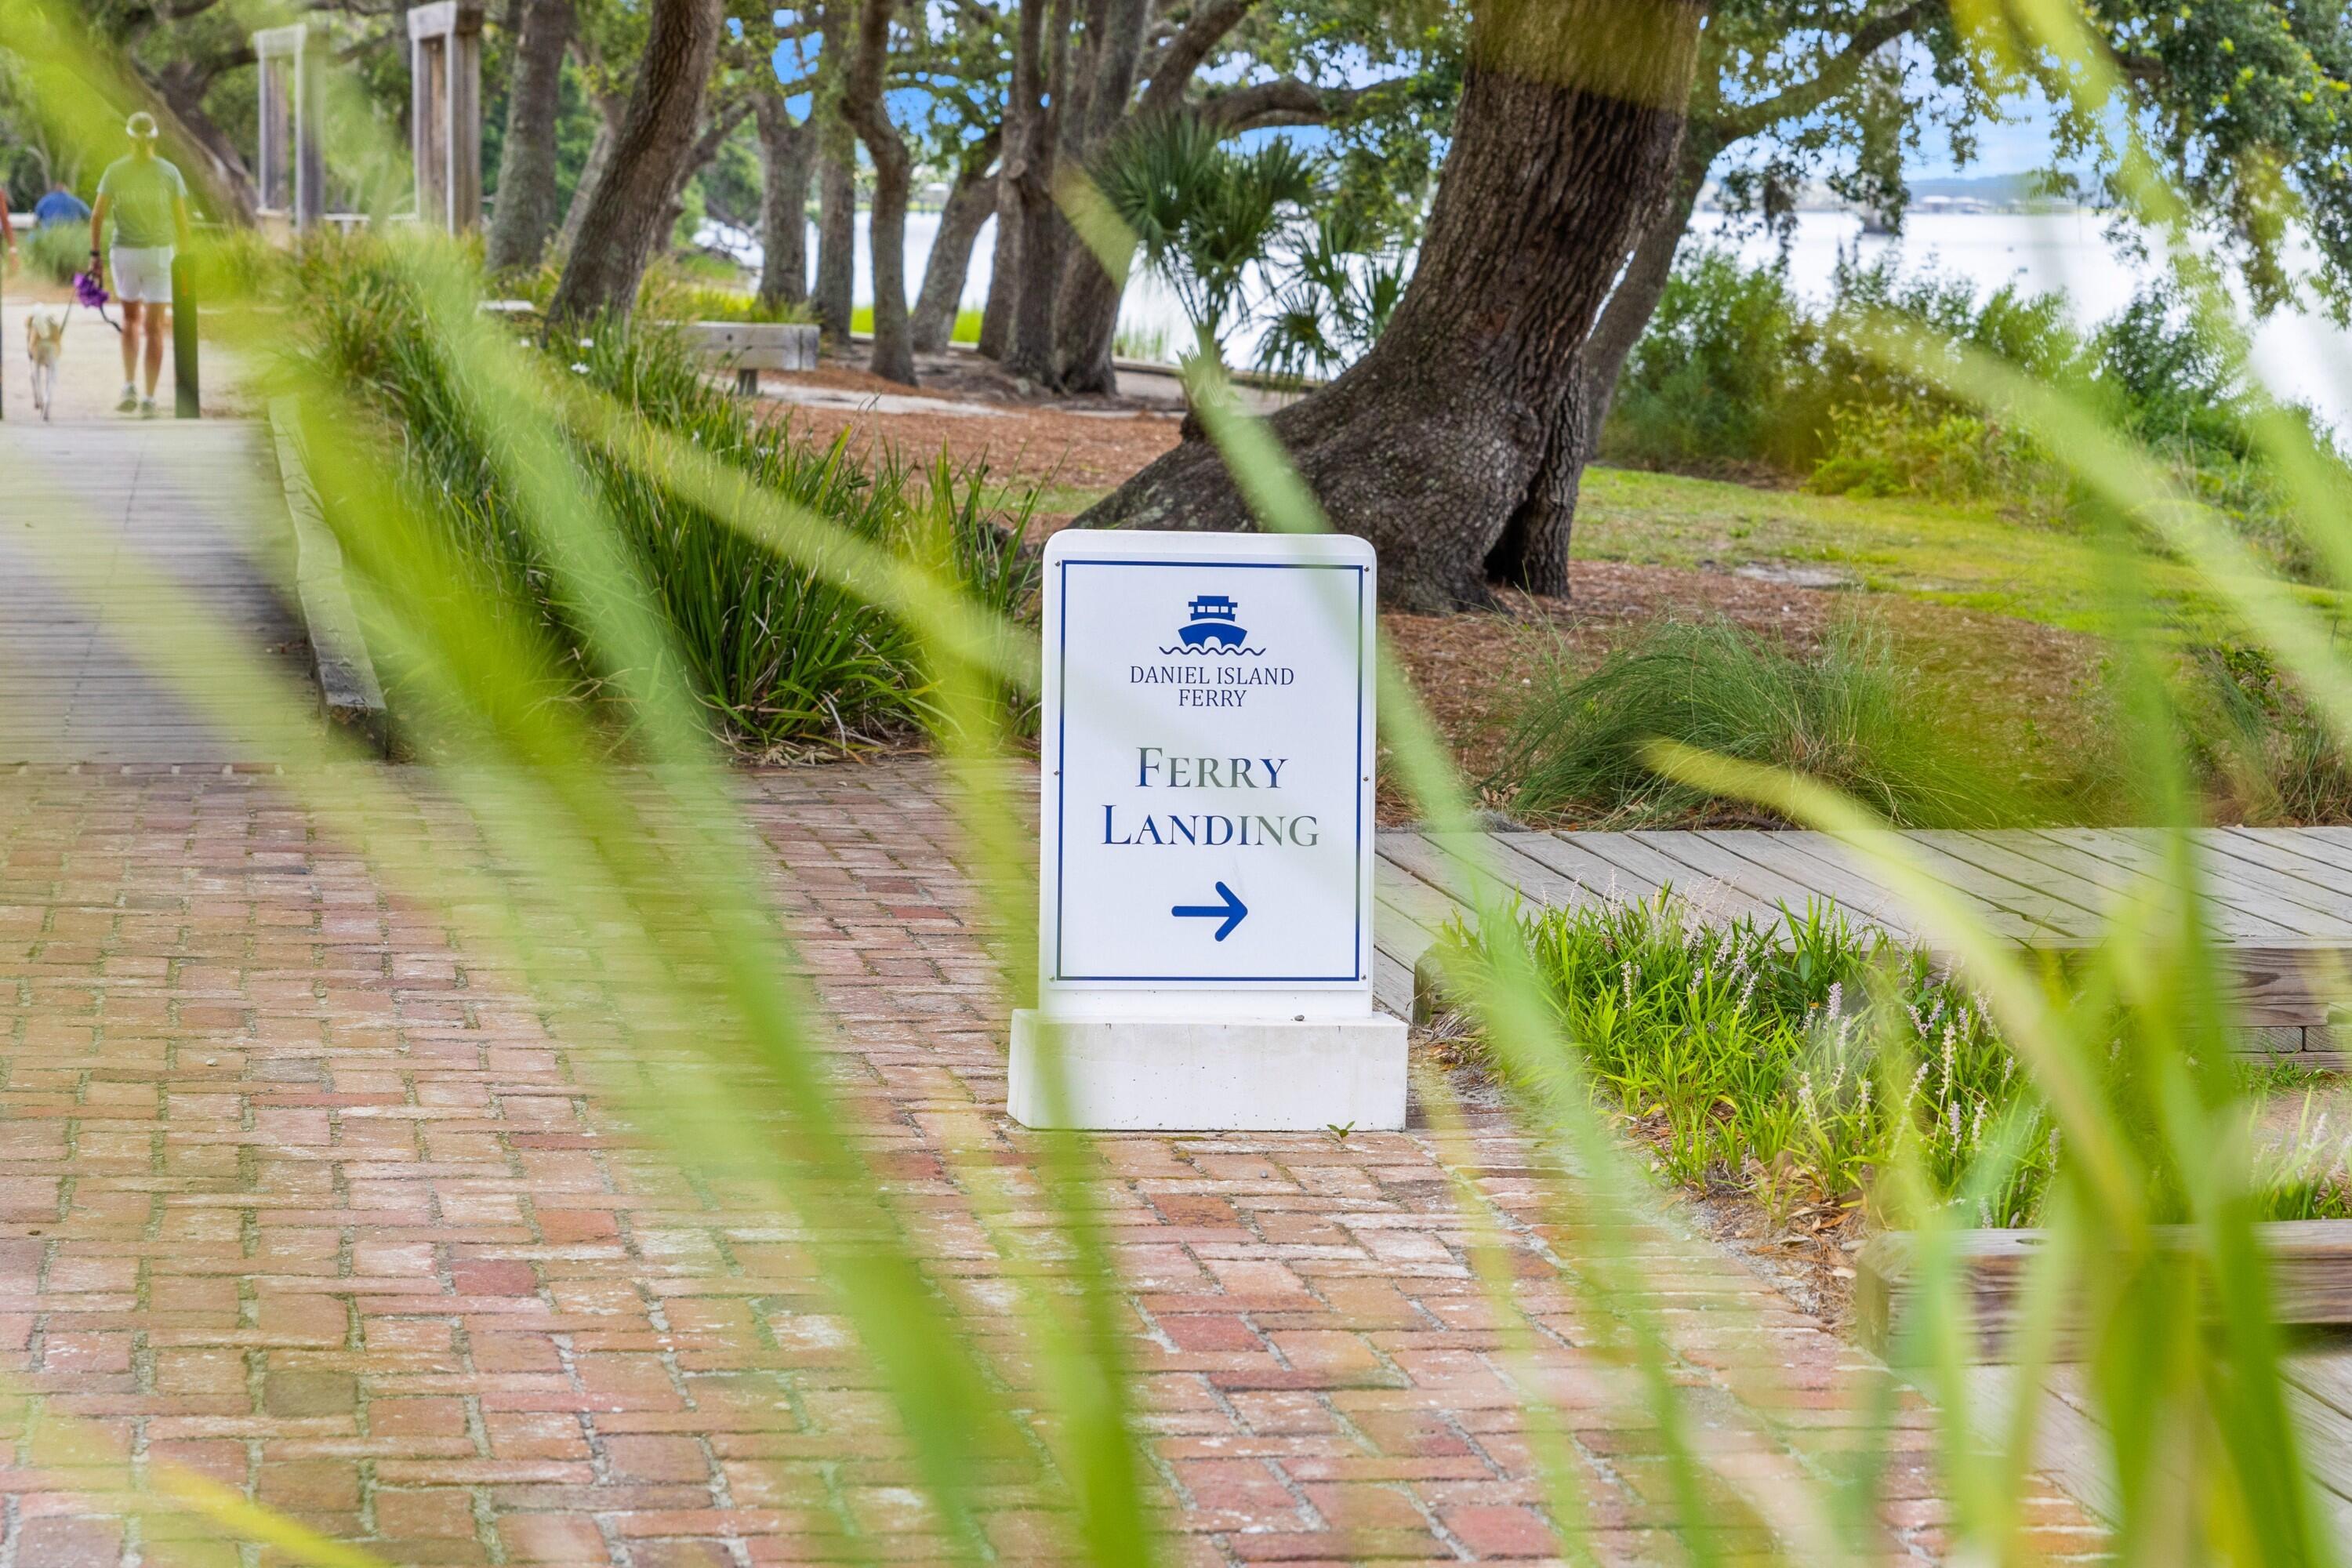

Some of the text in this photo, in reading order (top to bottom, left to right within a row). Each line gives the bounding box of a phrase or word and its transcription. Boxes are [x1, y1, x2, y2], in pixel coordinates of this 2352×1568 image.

[1130, 666, 1294, 685] DANIEL ISLAND
[1178, 688, 1247, 707] FERRY
[1134, 746, 1289, 789] FERRY
[1101, 804, 1319, 847] LANDING
